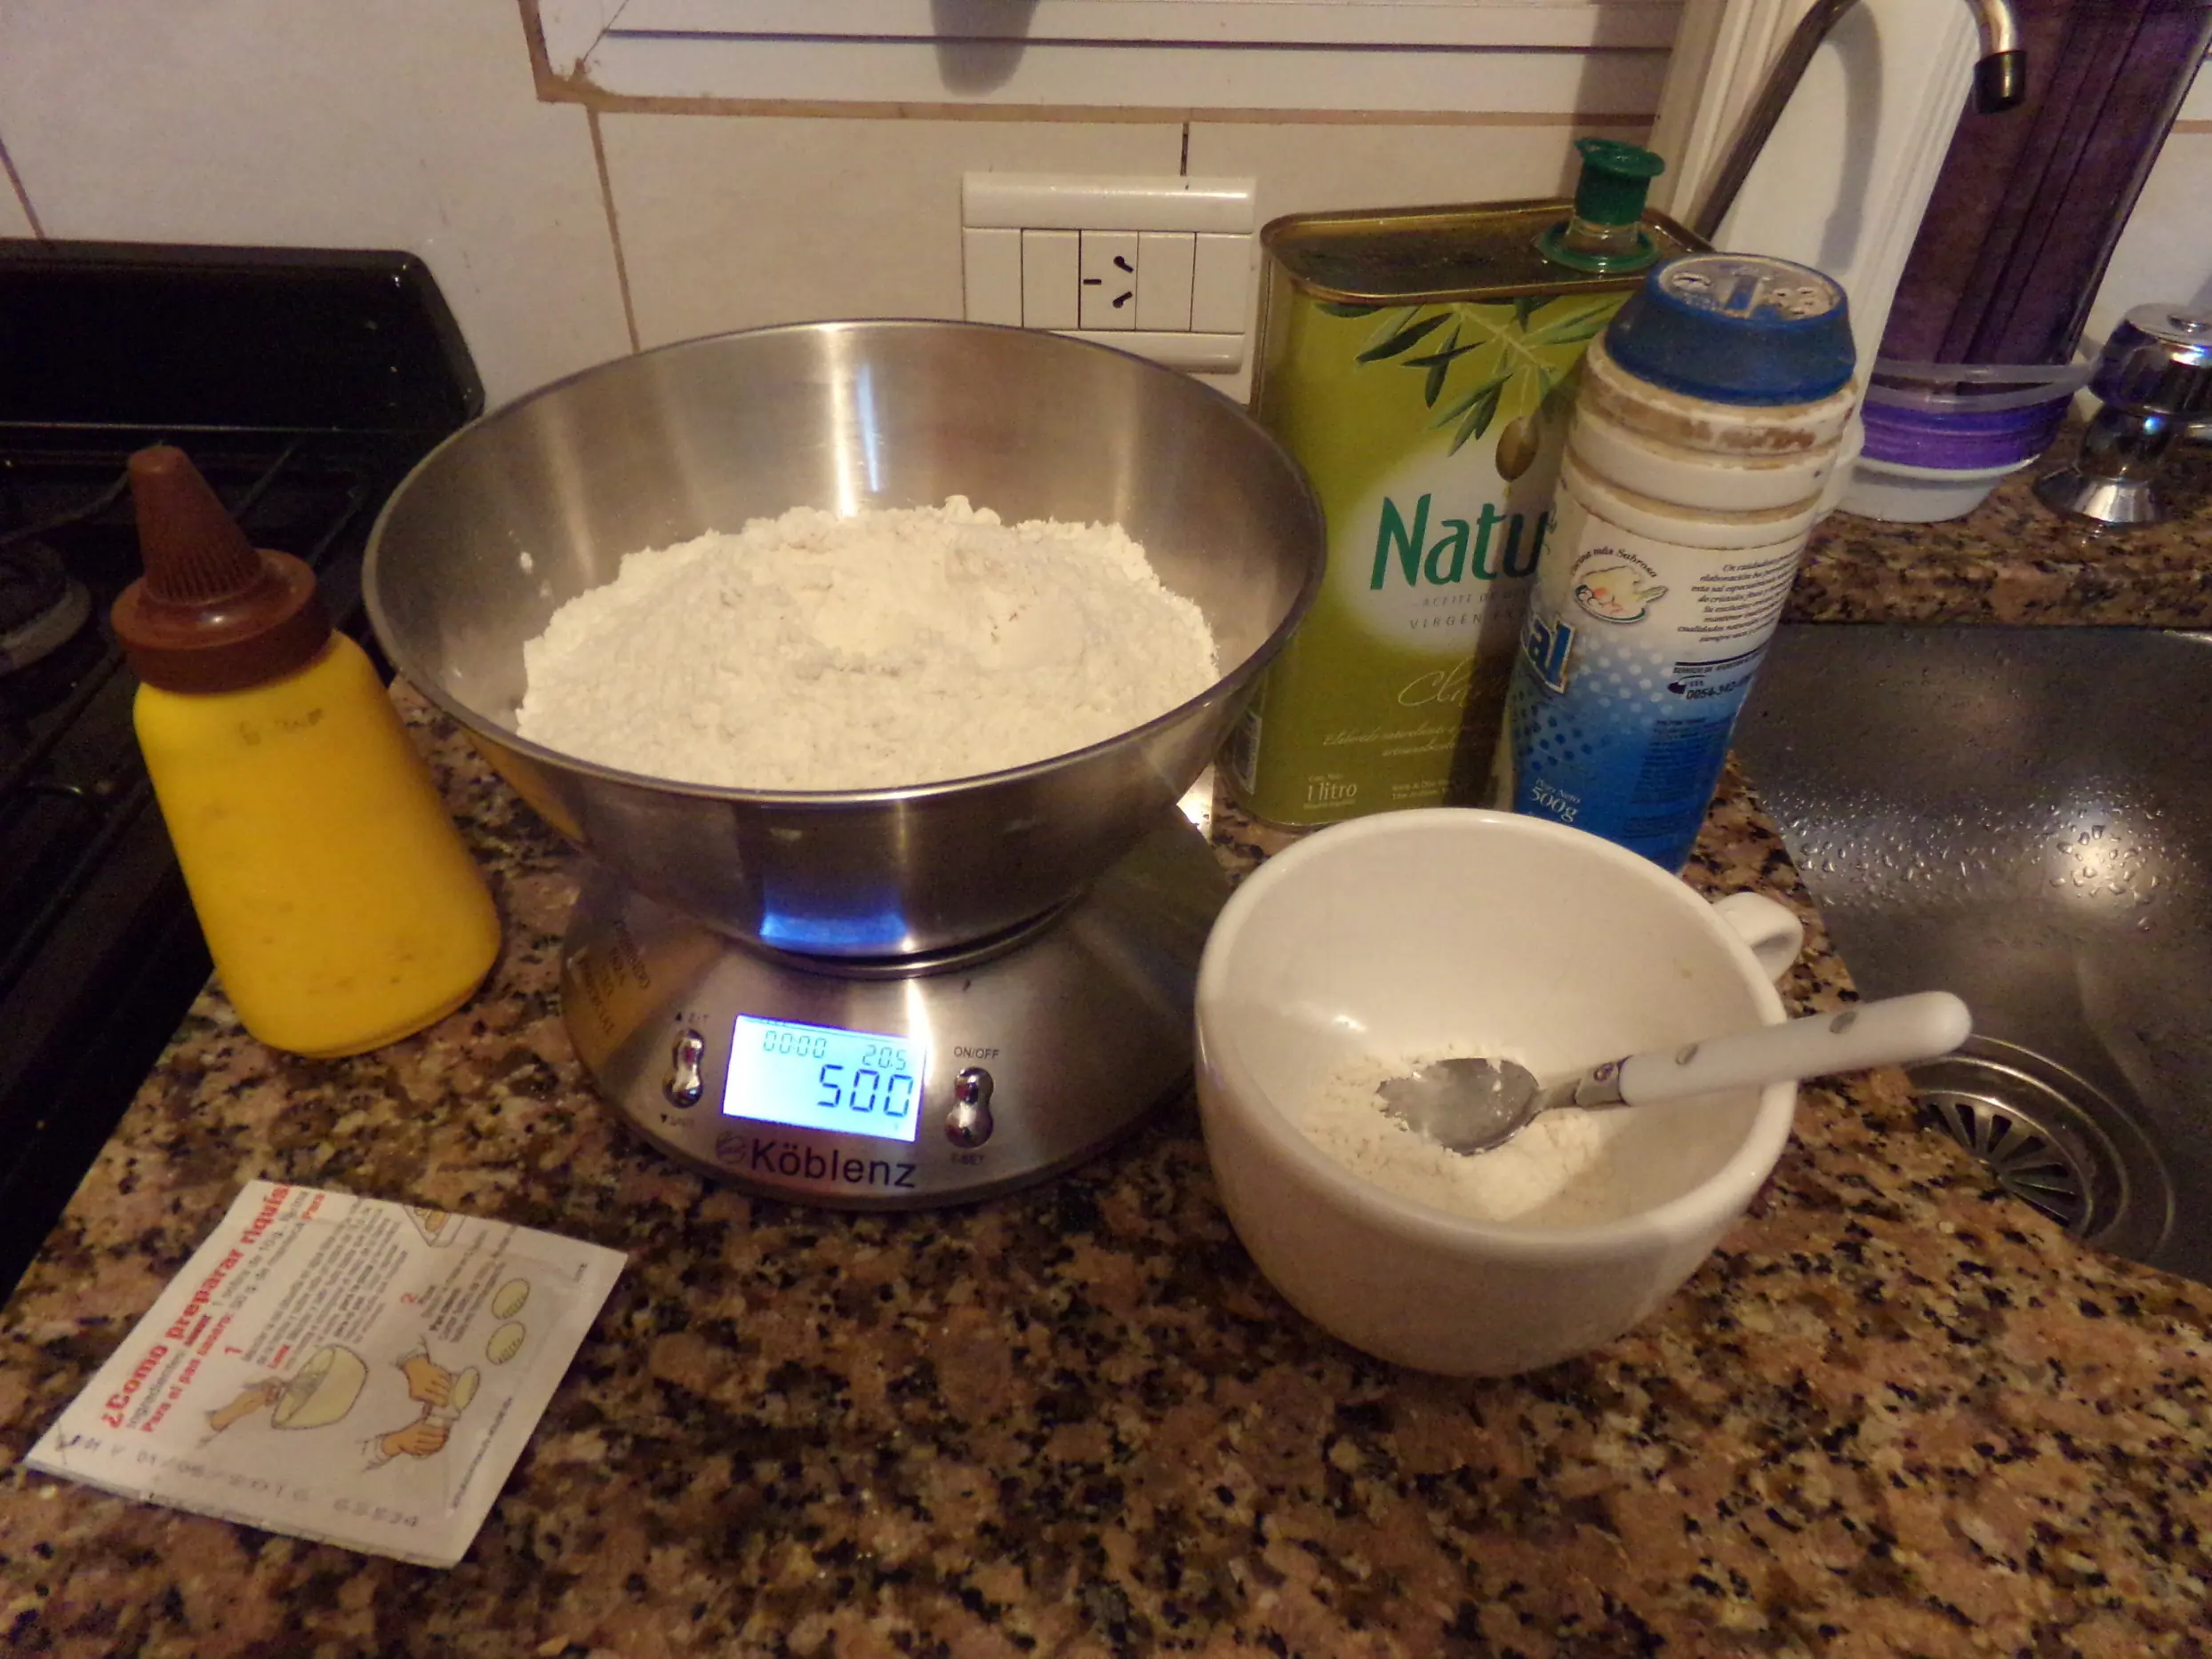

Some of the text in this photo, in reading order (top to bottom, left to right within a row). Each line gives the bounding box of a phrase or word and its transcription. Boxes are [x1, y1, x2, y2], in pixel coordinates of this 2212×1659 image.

[1370, 493, 1549, 590] Natu
[1617, 549, 1657, 578] Sabrosa
[1318, 781, 1358, 800] litro
[1530, 786, 1578, 822] 500g
[953, 1046, 1000, 1060] ON/OFF
[817, 1063, 914, 1118] 500
[750, 1138, 918, 1189] Köblenz
[165, 1249, 244, 1339] preparar
